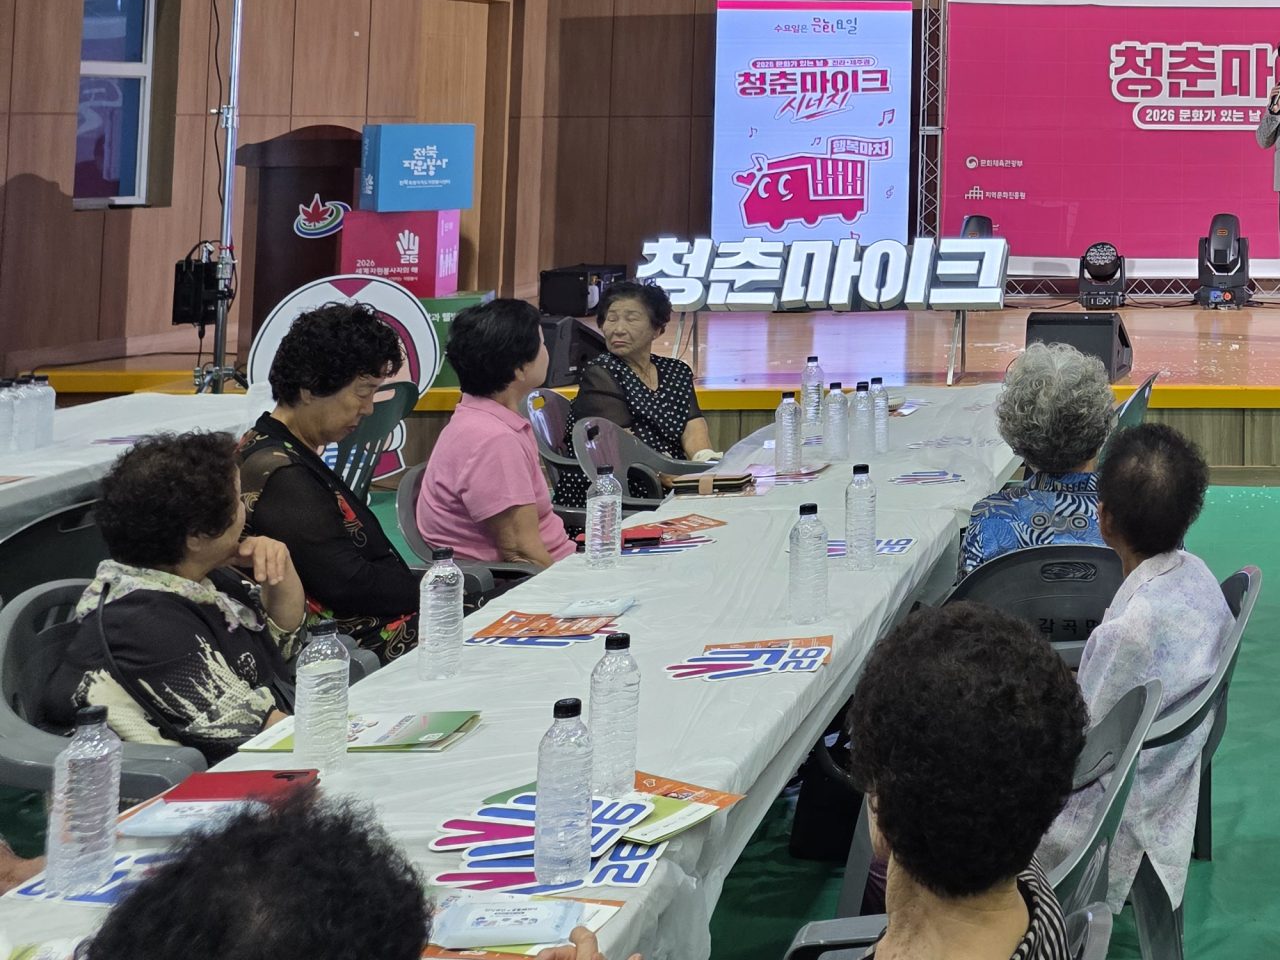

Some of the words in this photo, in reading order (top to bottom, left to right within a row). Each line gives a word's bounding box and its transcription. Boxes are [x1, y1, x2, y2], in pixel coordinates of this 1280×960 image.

[774, 24, 809, 33] 수요일은
[737, 69, 890, 96] 청춘마이크
[780, 91, 850, 117] 시너지
[1145, 109, 1175, 122] 2026
[1179, 109, 1216, 122] 문화가
[1220, 109, 1244, 122] 있는
[1249, 109, 1261, 122] 날
[413, 145, 438, 160] 전북
[402, 159, 448, 176] 자원봉사
[356, 259, 375, 267] 2026
[636, 237, 1009, 311] 청춘마이크
[778, 647, 826, 671] 26
